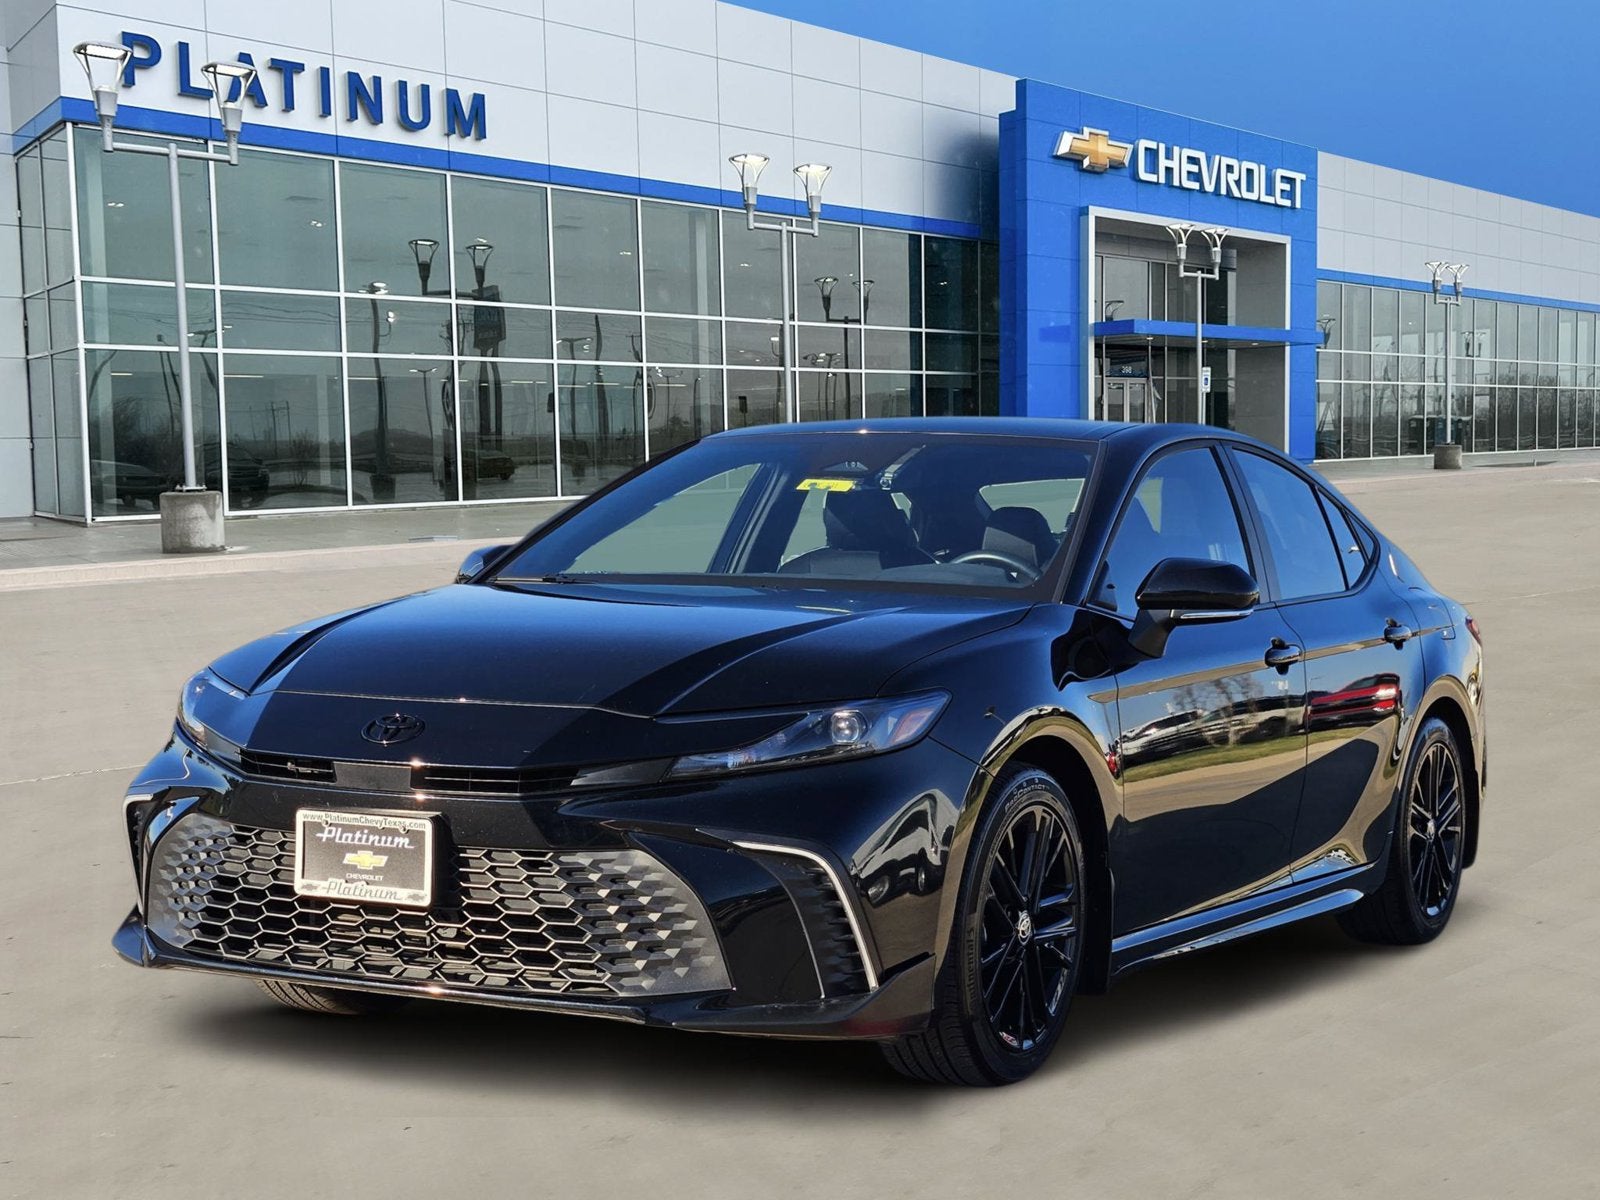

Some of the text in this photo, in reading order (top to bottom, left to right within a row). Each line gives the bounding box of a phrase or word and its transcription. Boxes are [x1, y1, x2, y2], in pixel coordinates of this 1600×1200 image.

[121, 31, 487, 141] PLATINUM
[1136, 138, 1306, 209] CHEVROLET
[302, 812, 426, 829] www.PlatinumChevyTexas.com
[315, 826, 416, 849] Platinum
[345, 872, 384, 881] CHEVROLET
[322, 880, 402, 901] Platinum
